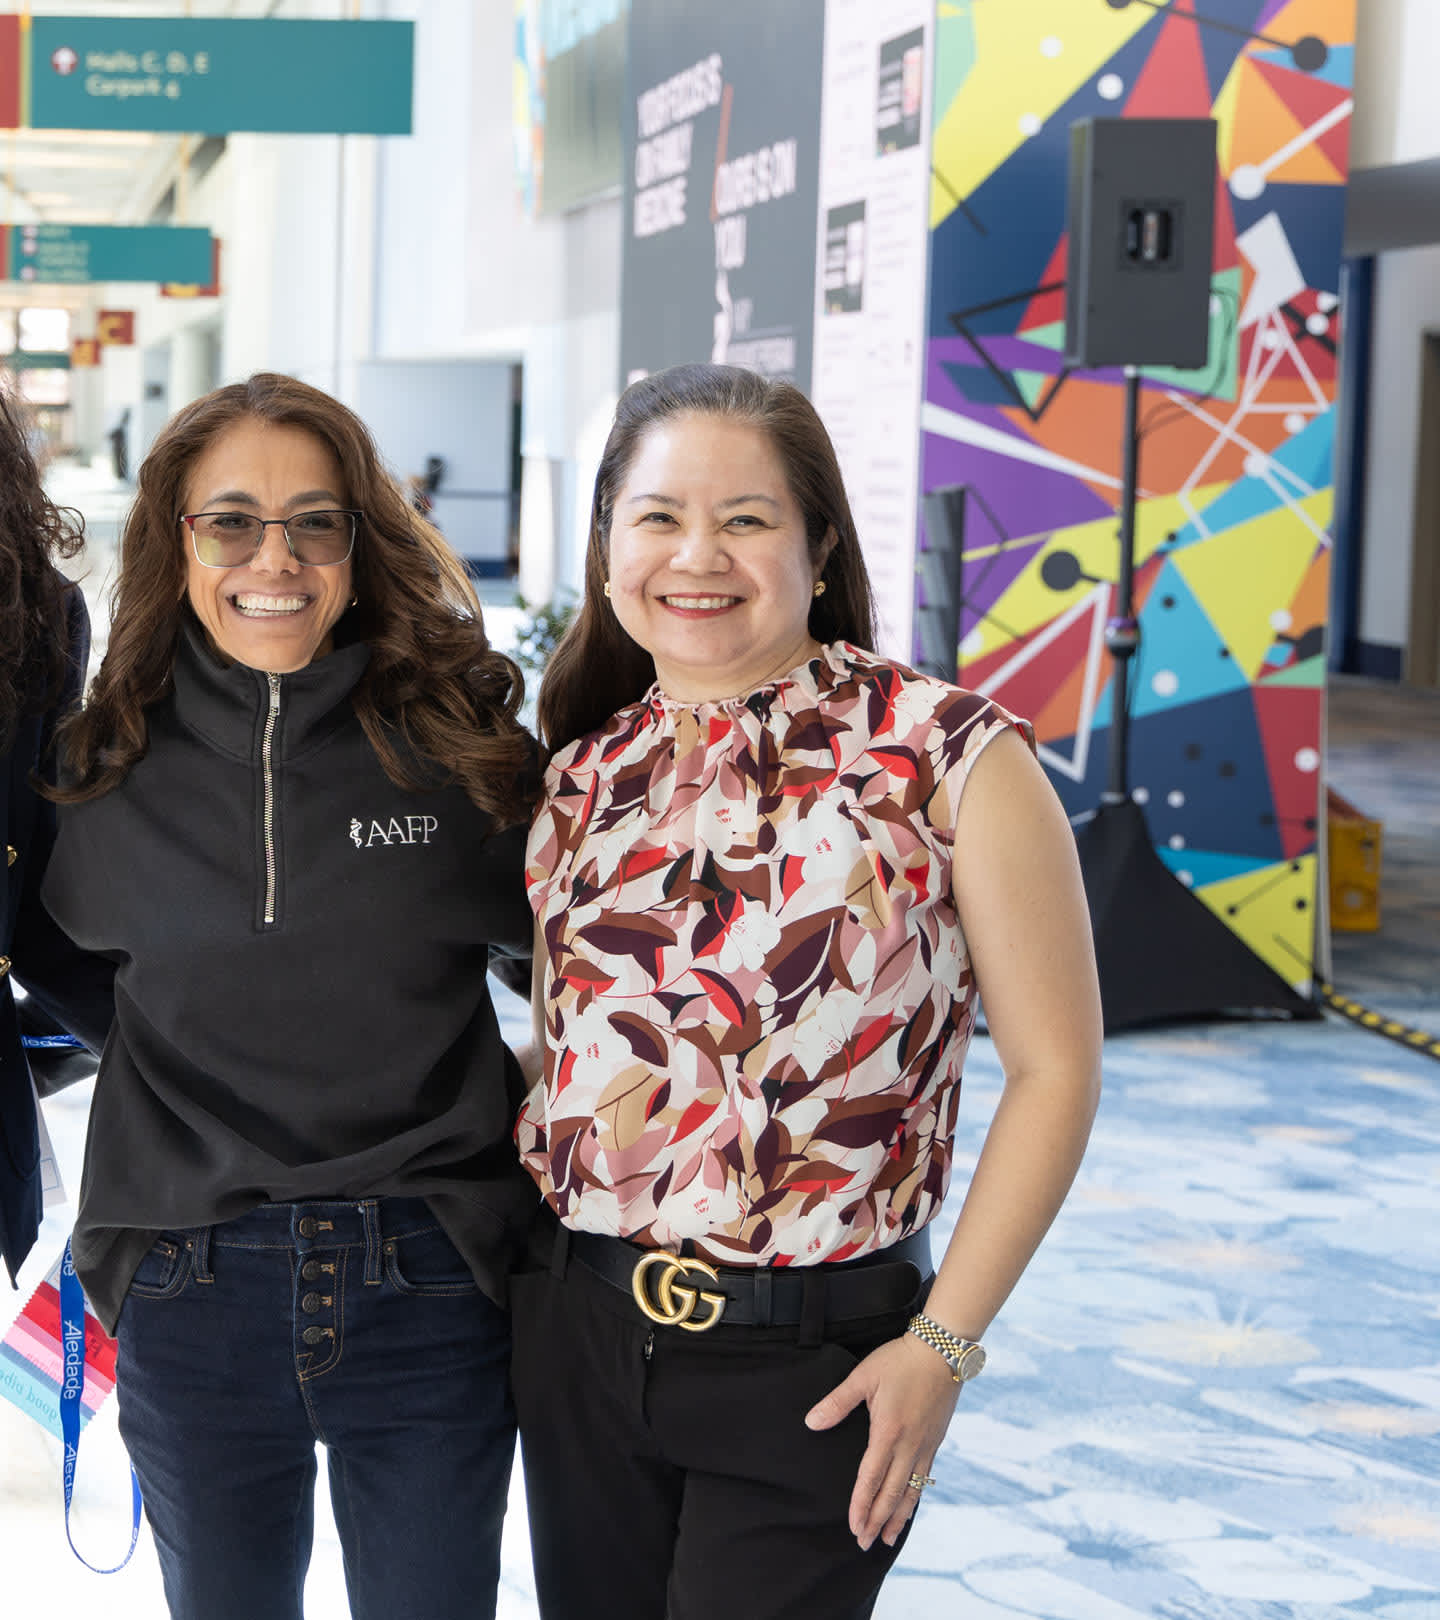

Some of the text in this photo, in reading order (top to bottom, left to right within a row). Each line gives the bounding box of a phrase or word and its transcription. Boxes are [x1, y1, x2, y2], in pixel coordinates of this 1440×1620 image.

[365, 815, 438, 847] AAFP
[63, 1318, 83, 1400] Aledade
[64, 1441, 77, 1512] Aleda
